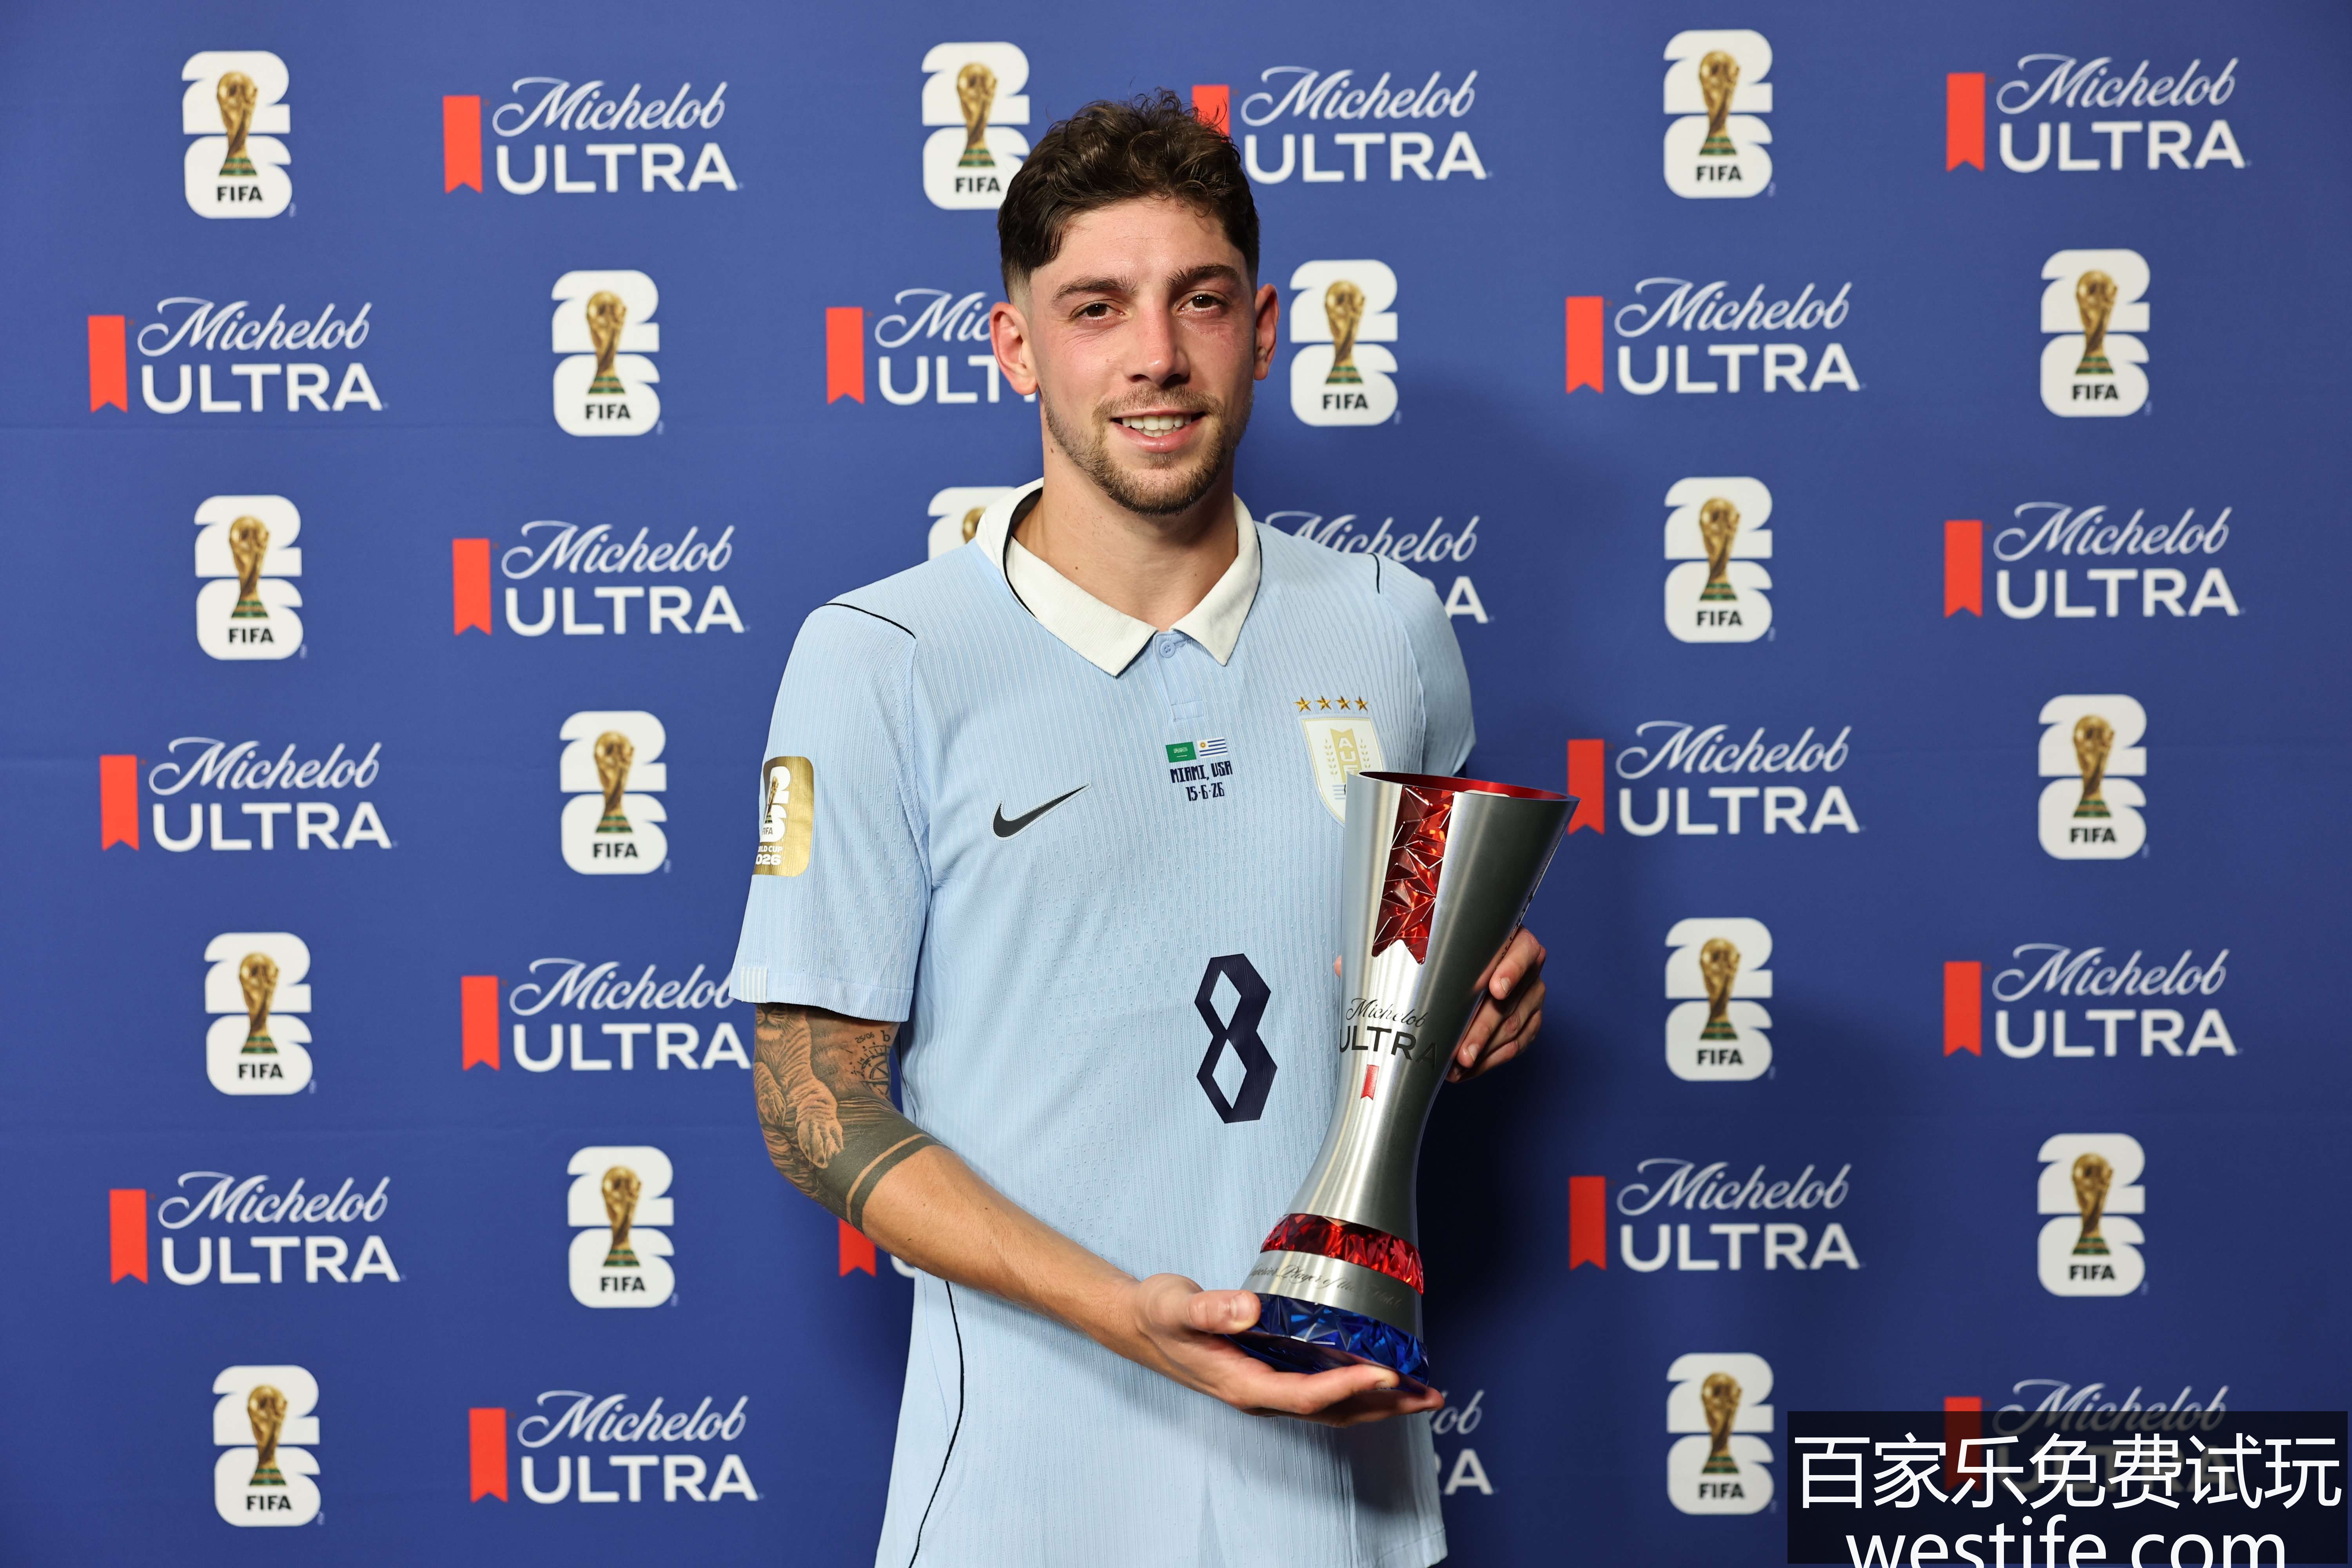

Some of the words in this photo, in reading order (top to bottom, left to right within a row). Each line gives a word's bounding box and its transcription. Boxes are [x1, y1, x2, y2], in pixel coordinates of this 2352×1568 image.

[492, 76, 728, 137] Michelob
[1241, 66, 1478, 127] Michelob
[1996, 53, 2238, 114] Michelob
[496, 142, 738, 195] ULTRA
[1244, 131, 1487, 185] ULTRA
[1999, 119, 2245, 173] ULTRA
[216, 185, 263, 202] FIFA
[955, 176, 1001, 193] FIFA
[1696, 165, 1742, 181] FIFA
[137, 296, 372, 357] Michelob
[1614, 277, 1852, 338] Michelob
[141, 362, 383, 414] ULTRA
[878, 355, 1036, 406] ULT
[1617, 343, 1860, 396] ULTRA
[2072, 384, 2119, 401] FIFA
[585, 403, 631, 420] FIFA
[1322, 393, 1369, 410] FIFA
[501, 520, 735, 580] Michelob
[1993, 502, 2232, 562] Michelob
[505, 585, 745, 637] ULTRA
[1696, 610, 1742, 626] FIFA
[1996, 567, 2240, 620] ULTRA
[229, 628, 274, 644] FIFA
[148, 737, 382, 796] Michelob
[1210, 760, 1232, 777] USA
[1616, 720, 1851, 779] Michelob
[152, 801, 392, 853] ULTRA
[1619, 786, 1860, 837] ULTRA
[2070, 827, 2117, 843] FIFA
[593, 842, 639, 858] FIFA
[756, 854, 781, 865] 026
[1992, 943, 2229, 1002] Michelob
[1346, 998, 1428, 1027] Michelob
[1995, 1008, 2238, 1059] ULTRA
[513, 1022, 752, 1073] ULTRA
[1194, 953, 1278, 1124] 8
[1339, 1025, 1437, 1070] ULTRA
[1697, 1048, 1744, 1065] FIFA
[238, 1063, 283, 1079] FIFA
[158, 1171, 390, 1230] Michelob
[1617, 1158, 1851, 1216] Michelob
[162, 1235, 401, 1286] ULTRA
[1620, 1223, 1860, 1273] ULTRA
[2069, 1264, 2116, 1281] FIFA
[600, 1276, 646, 1292] FIFA
[517, 1390, 748, 1448] Michelob
[1992, 1378, 2230, 1436] Michelob
[246, 1495, 292, 1511] FIFA
[521, 1454, 759, 1504] ULTRA
[1698, 1482, 1745, 1499] FIFA
